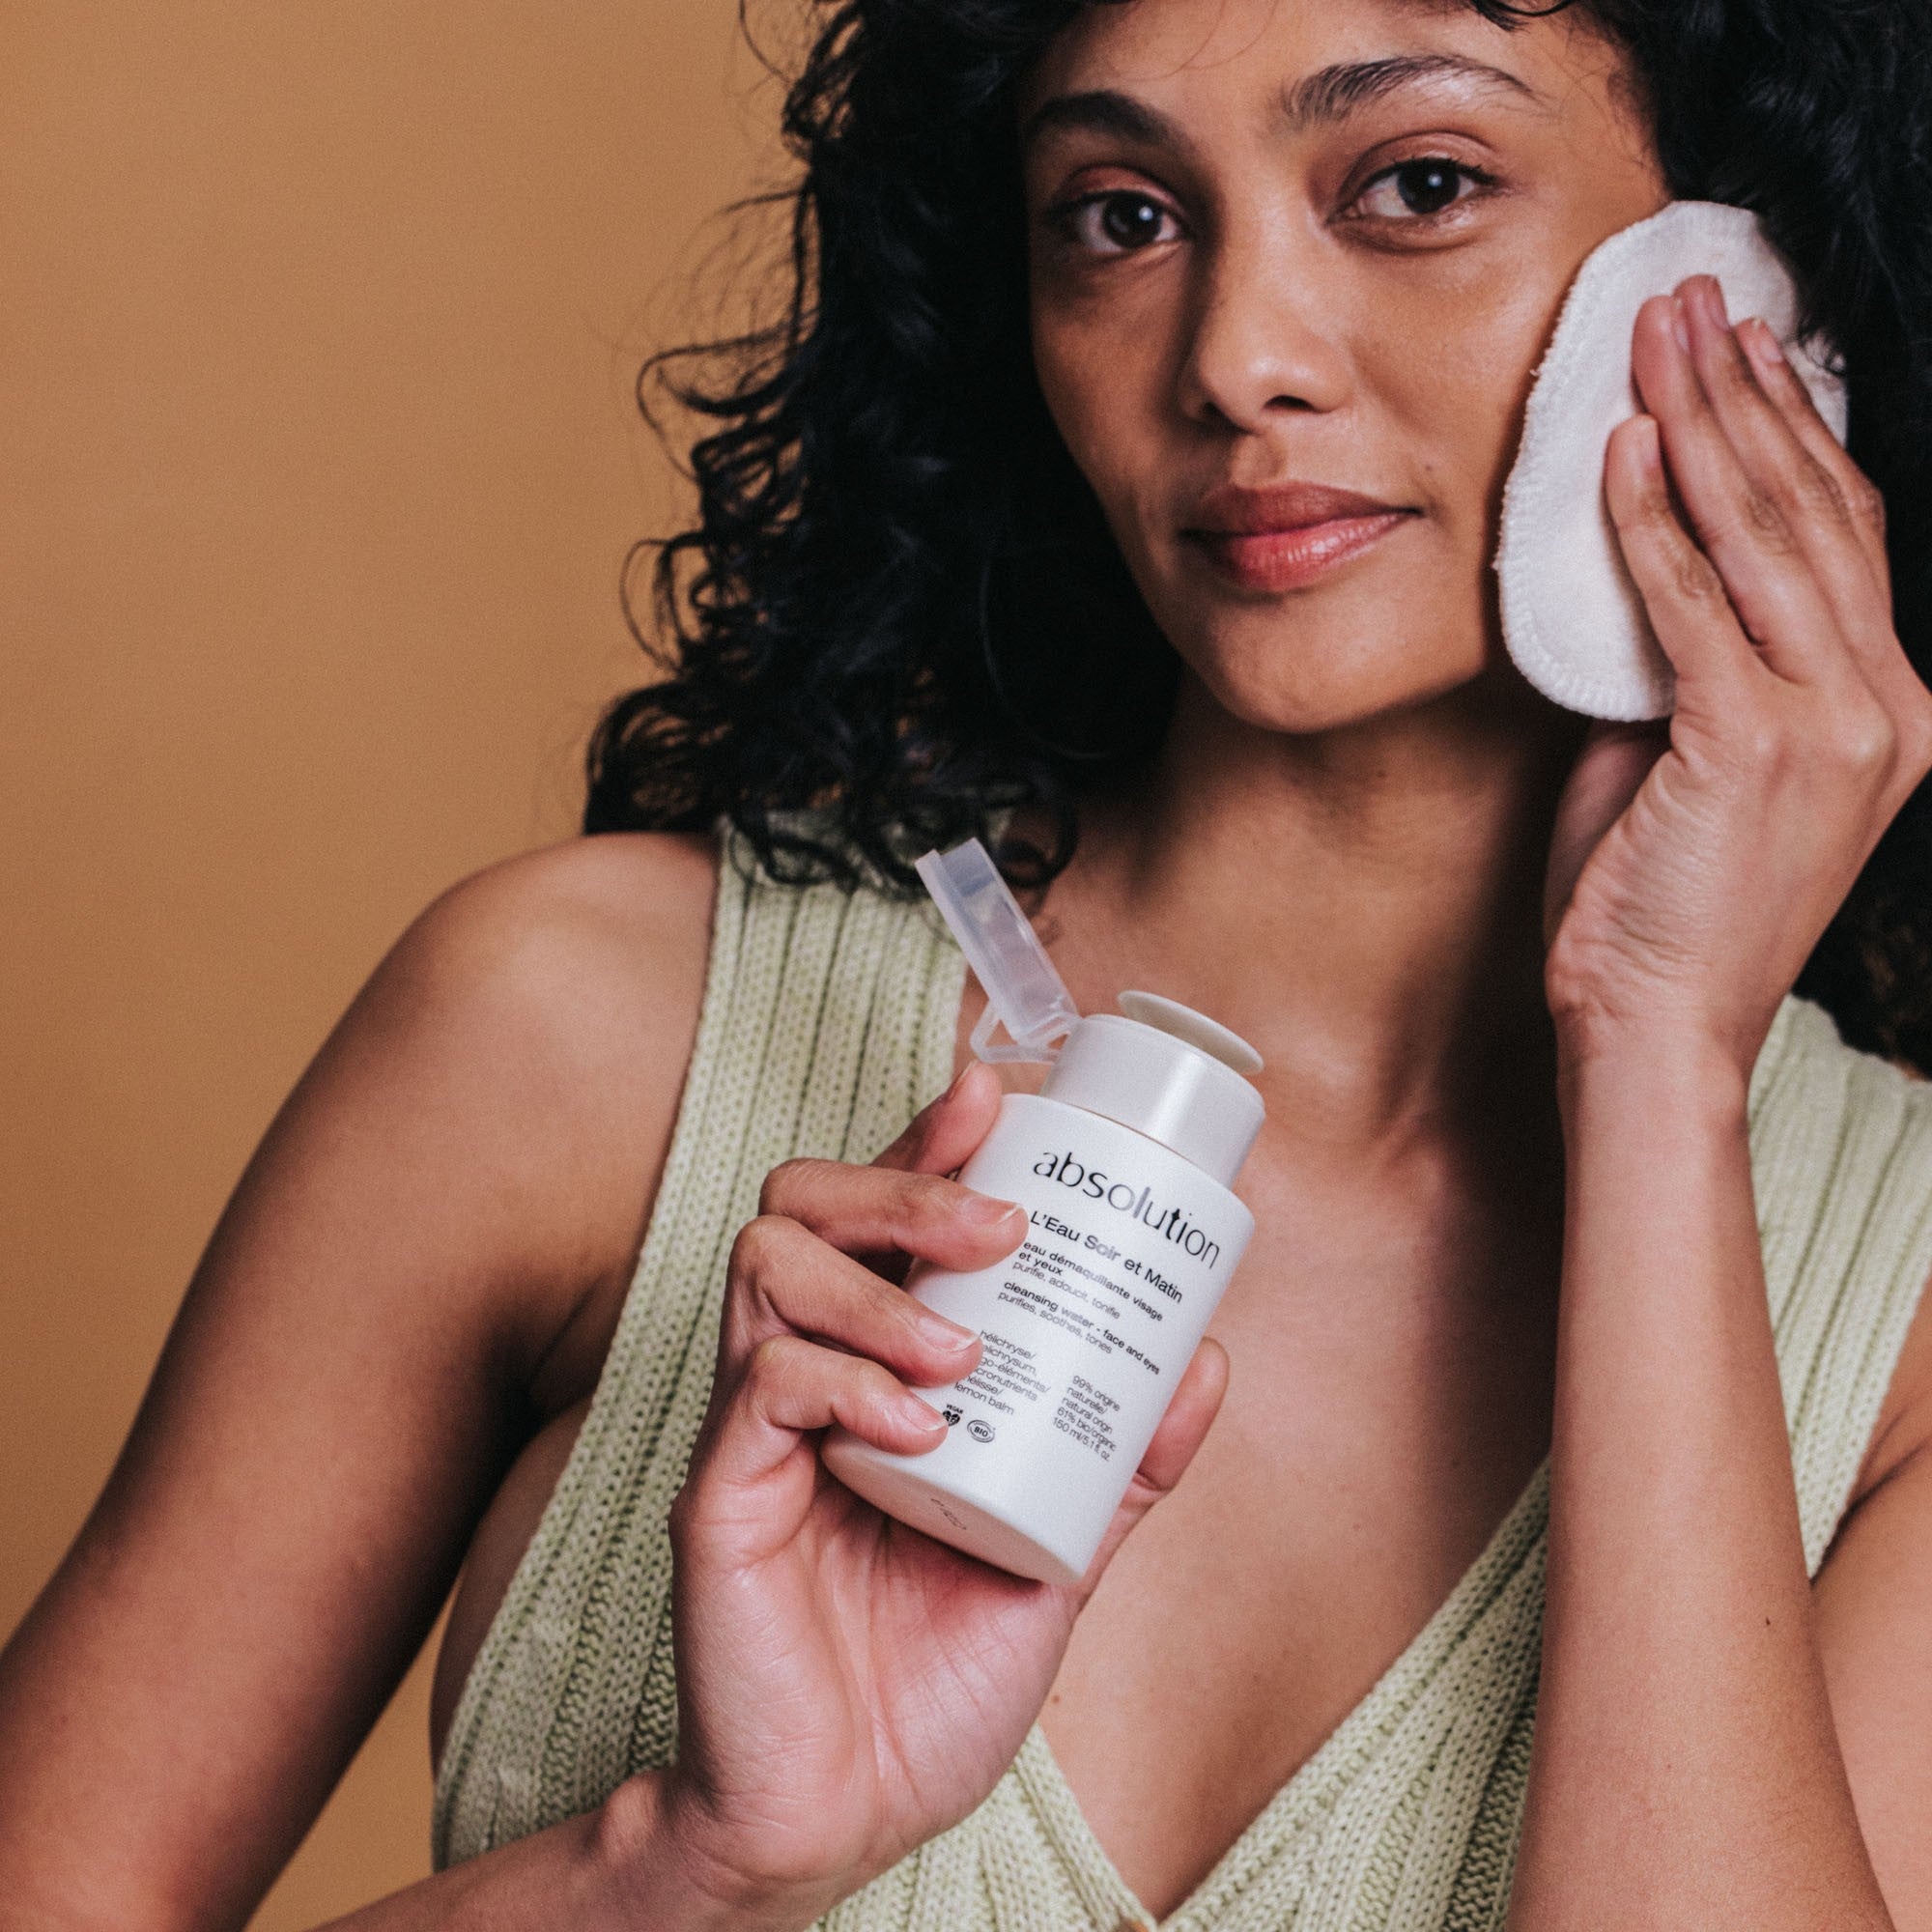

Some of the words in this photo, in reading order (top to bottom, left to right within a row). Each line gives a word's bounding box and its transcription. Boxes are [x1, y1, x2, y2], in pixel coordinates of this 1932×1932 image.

[1033, 1151, 1220, 1270] absolution
[1018, 1252, 1032, 1262] et
[1033, 1258, 1064, 1276] yeux
[1030, 1210, 1081, 1242] L'Eau
[1084, 1235, 1122, 1262] Soir
[1123, 1259, 1143, 1276] et
[1144, 1268, 1183, 1304] Matin
[1023, 1241, 1047, 1257] eau
[1049, 1252, 1130, 1299] démaquillante
[1132, 1296, 1163, 1321] visage
[1092, 1297, 1121, 1320] tonifie
[1004, 1281, 1059, 1313] cleansing
[1061, 1307, 1094, 1329] water
[1102, 1329, 1125, 1349] face
[1125, 1346, 1144, 1361] and
[1143, 1357, 1160, 1375] eyes
[1085, 1332, 1113, 1354] tones
[975, 1367, 1038, 1402] cronutrients
[980, 1356, 1051, 1393] go-éléments/
[1072, 1375, 1094, 1394] 99%
[987, 1395, 1015, 1416] balm
[1057, 1406, 1076, 1424] 61%
[1062, 1397, 1094, 1420] natural
[974, 1426, 988, 1437] BIO
[1052, 1416, 1070, 1433] 150
